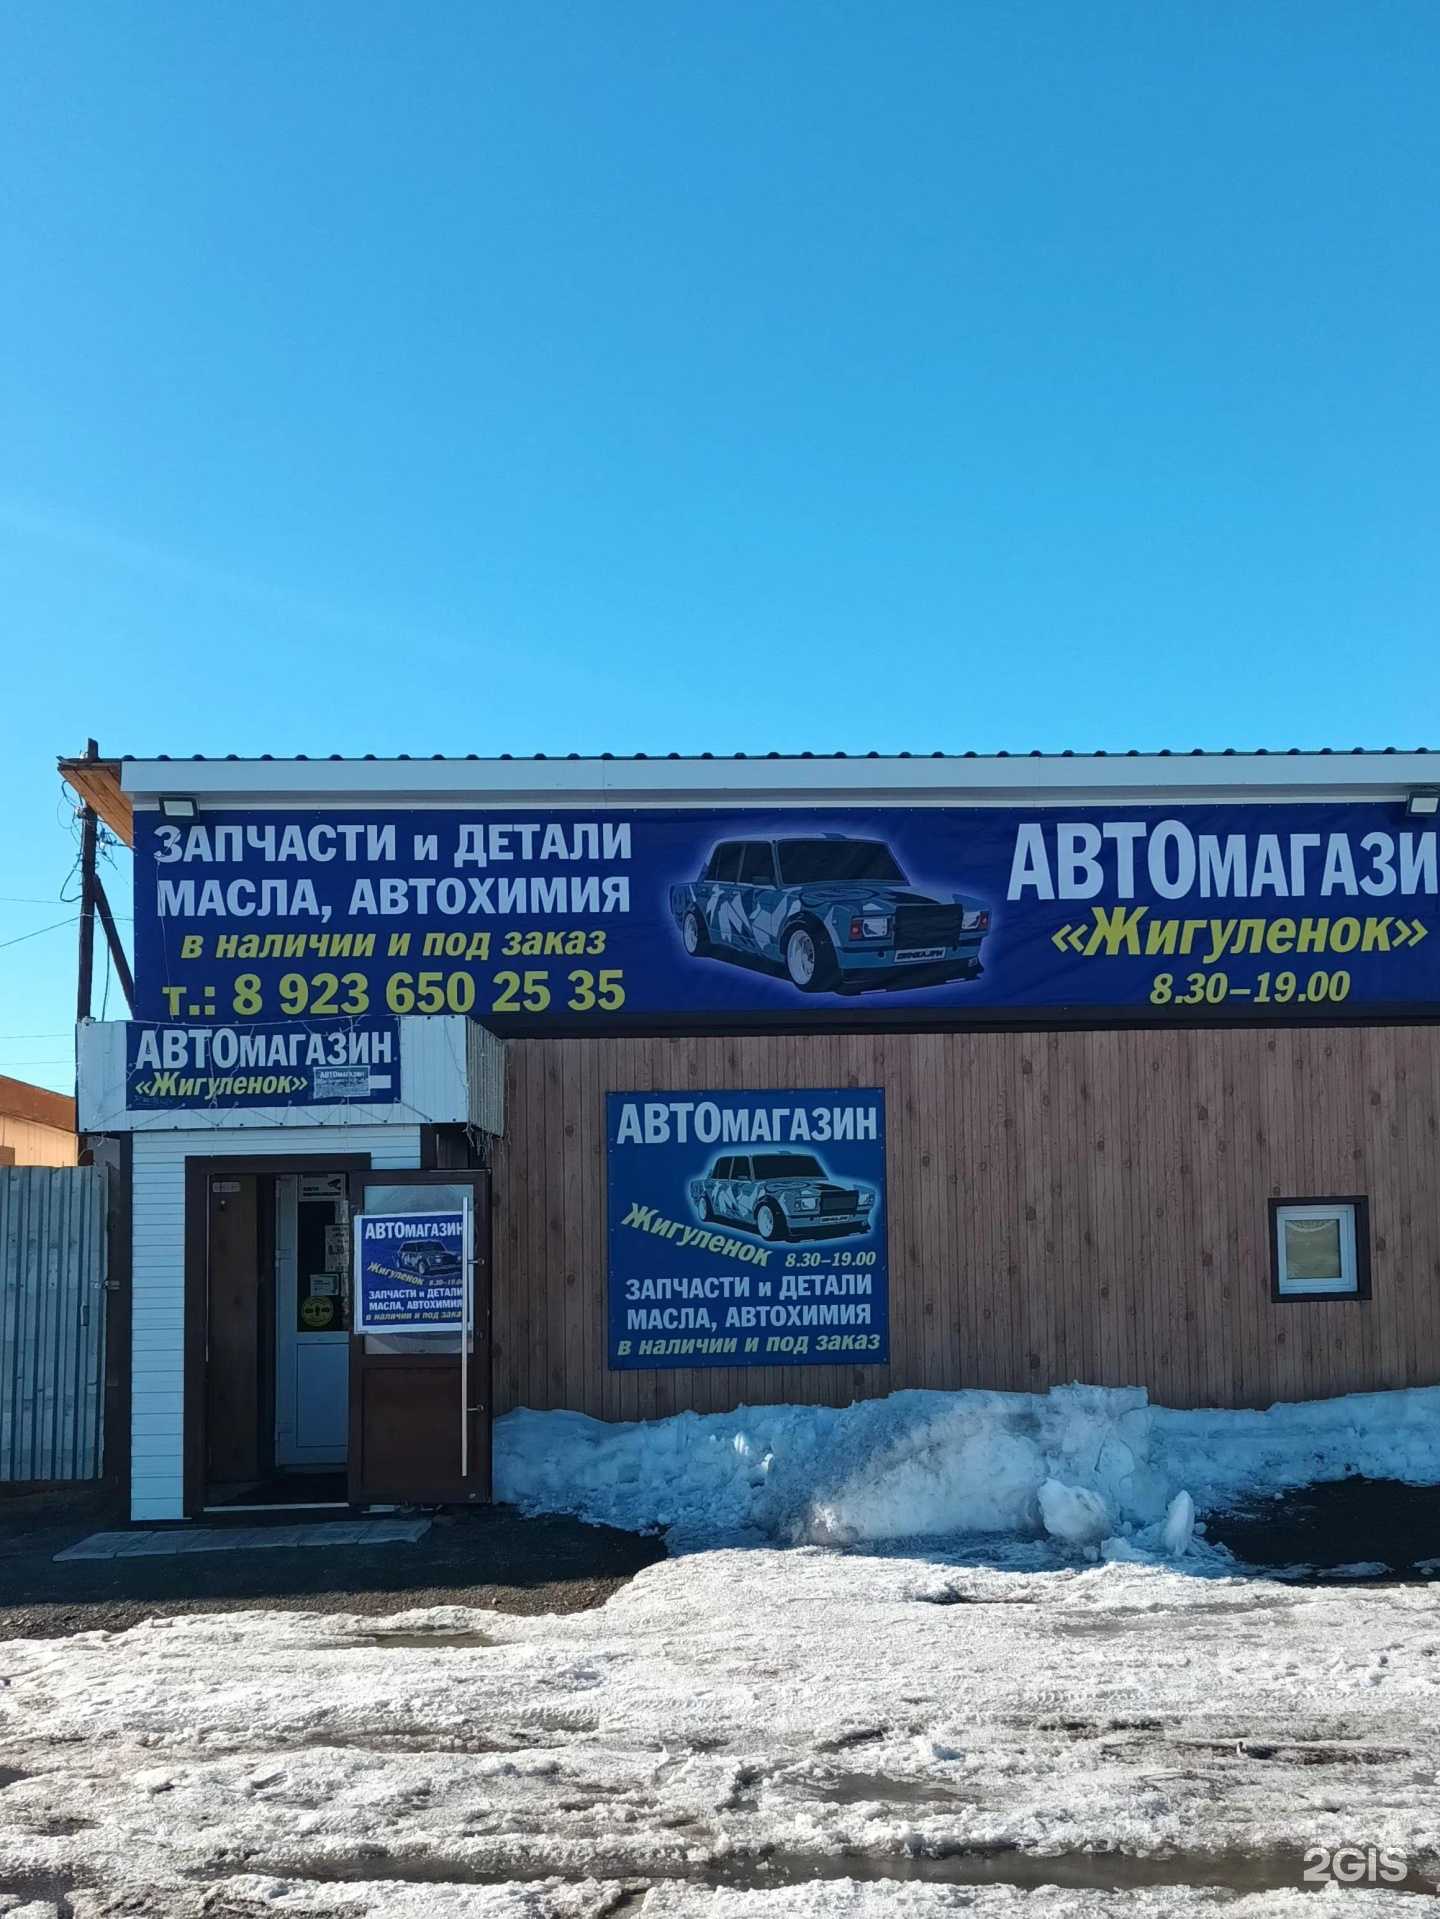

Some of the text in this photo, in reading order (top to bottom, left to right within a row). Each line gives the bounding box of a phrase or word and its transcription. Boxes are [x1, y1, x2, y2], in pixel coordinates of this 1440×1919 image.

[154, 823, 632, 868] ЗАПЧАСТИ и ДЕТАЛИ
[1007, 819, 1439, 900] АВТОМАГАЗИ
[157, 876, 631, 924] МАСЛА, АВТОХИМИЯ
[181, 930, 607, 961] в наличии и под заказ
[1051, 905, 1429, 964] «Жигуленок»
[162, 969, 626, 1016] т.: 8 923 650 25 35
[136, 1028, 392, 1070] АВТОМАГАЗИН
[136, 1071, 308, 1101] «Жигуленок»
[617, 1101, 877, 1144] АВТОМАГАЗИН
[620, 1202, 773, 1267] Жигуленок
[367, 1261, 425, 1286] Жигуленок
[625, 1274, 872, 1300] ЗАПЧАСТИ и ДЕТАЛИ
[368, 1289, 417, 1300] ЗАПЧАСТИ
[369, 1301, 405, 1311] МАСЛА,
[627, 1304, 871, 1332] МАСЛА, АВТОХИМИЯ
[617, 1334, 880, 1355] в наличии и под заказ
